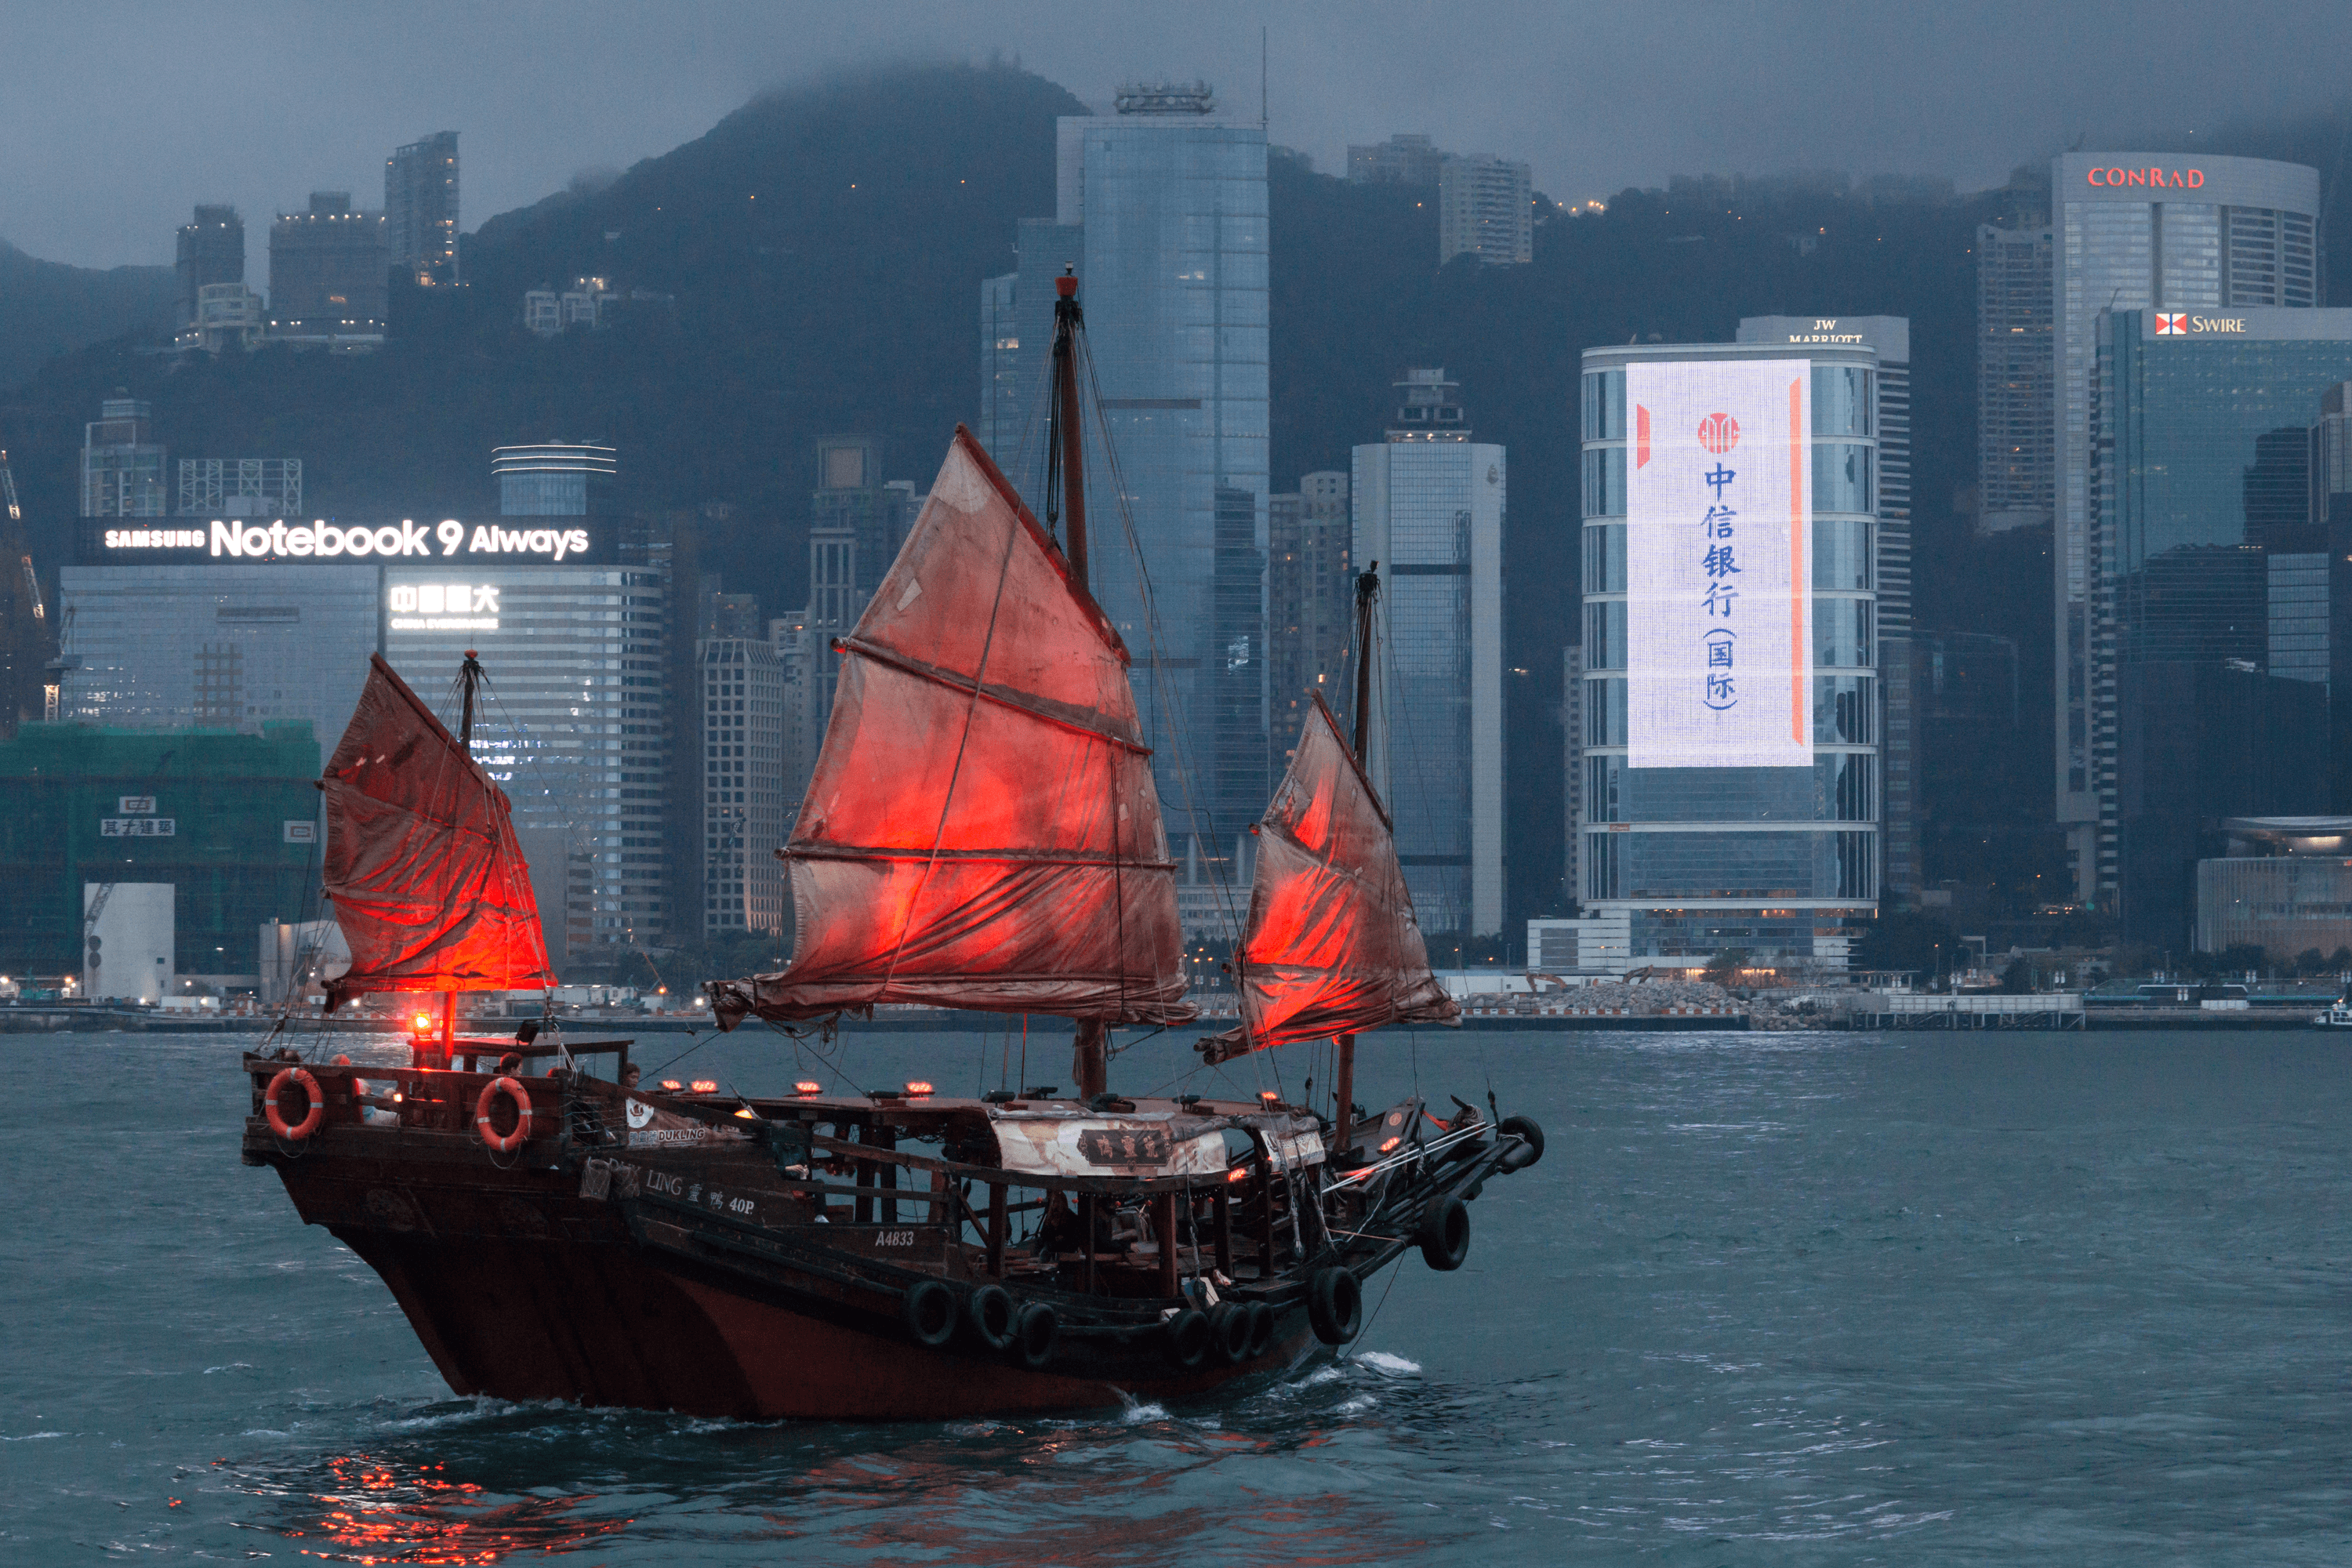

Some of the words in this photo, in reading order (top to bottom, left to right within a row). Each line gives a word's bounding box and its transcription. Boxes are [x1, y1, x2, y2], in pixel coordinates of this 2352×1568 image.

[2088, 168, 2205, 189] CONRAD
[1813, 320, 1837, 330] JW
[1789, 335, 1863, 343] MARRIOTT
[105, 530, 205, 548] SAMSUNG
[211, 519, 430, 556] Notebook
[437, 520, 464, 555] 9
[469, 524, 589, 561] Always
[658, 1129, 705, 1142] DUKLING
[646, 1169, 684, 1196] LING
[875, 1230, 914, 1247] A4833
